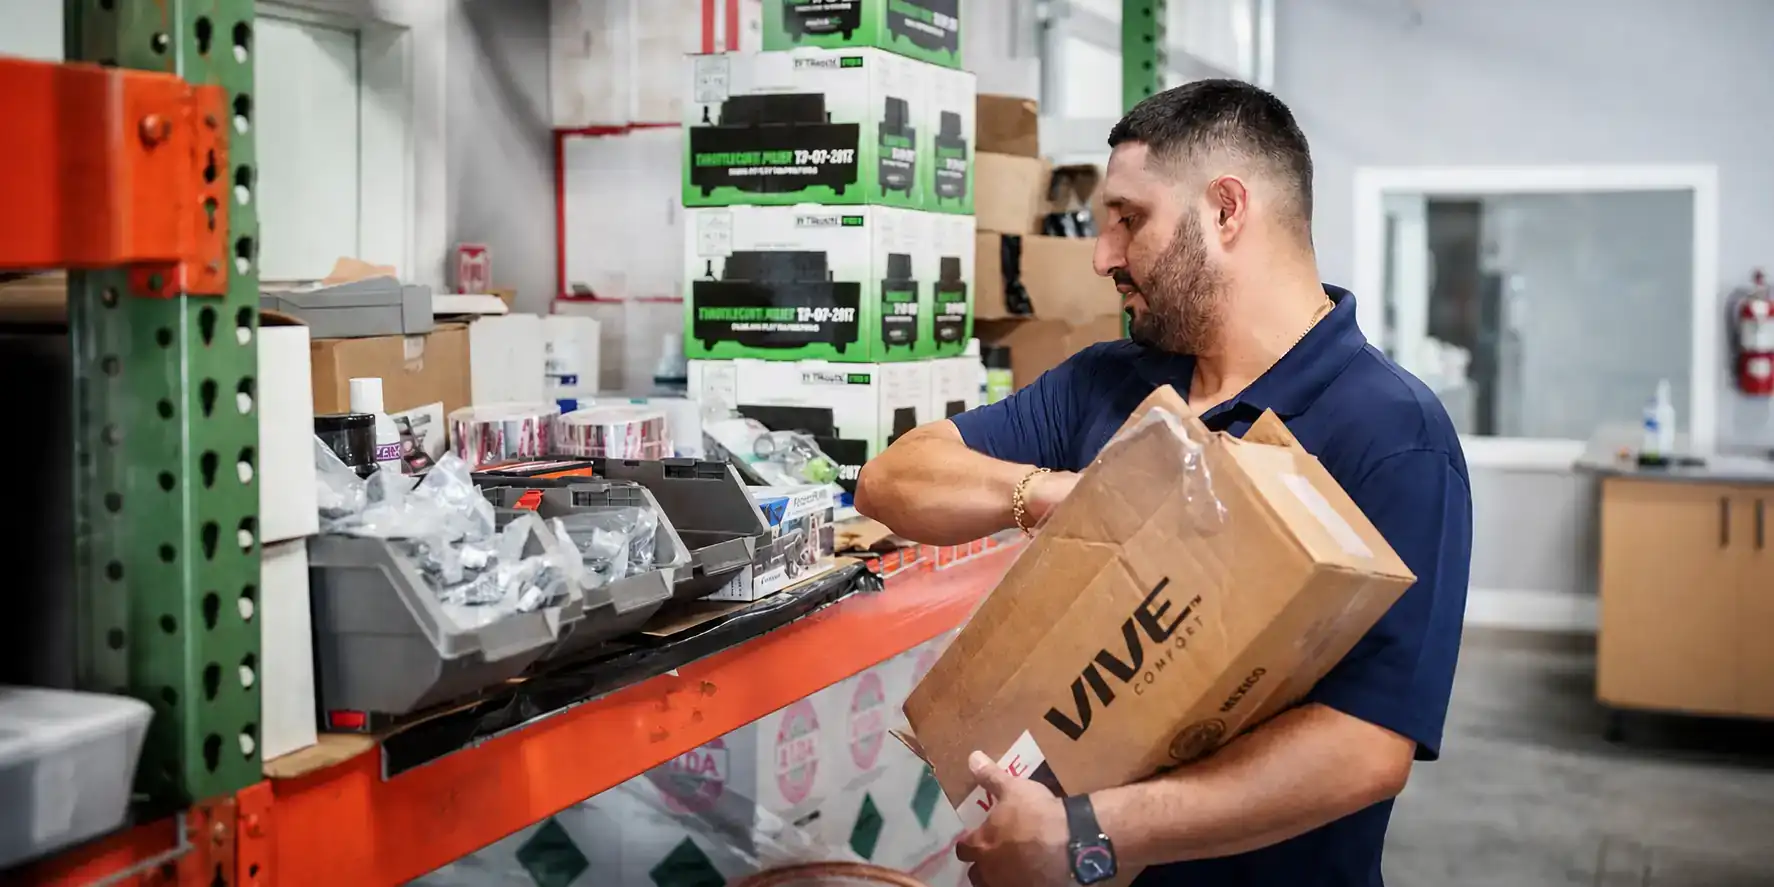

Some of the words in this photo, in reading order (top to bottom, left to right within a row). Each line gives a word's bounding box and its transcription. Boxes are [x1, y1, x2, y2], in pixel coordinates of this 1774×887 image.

[1133, 615, 1204, 696] COMFORT
[1219, 667, 1267, 712] MEXICO
[976, 754, 1029, 812] VE
